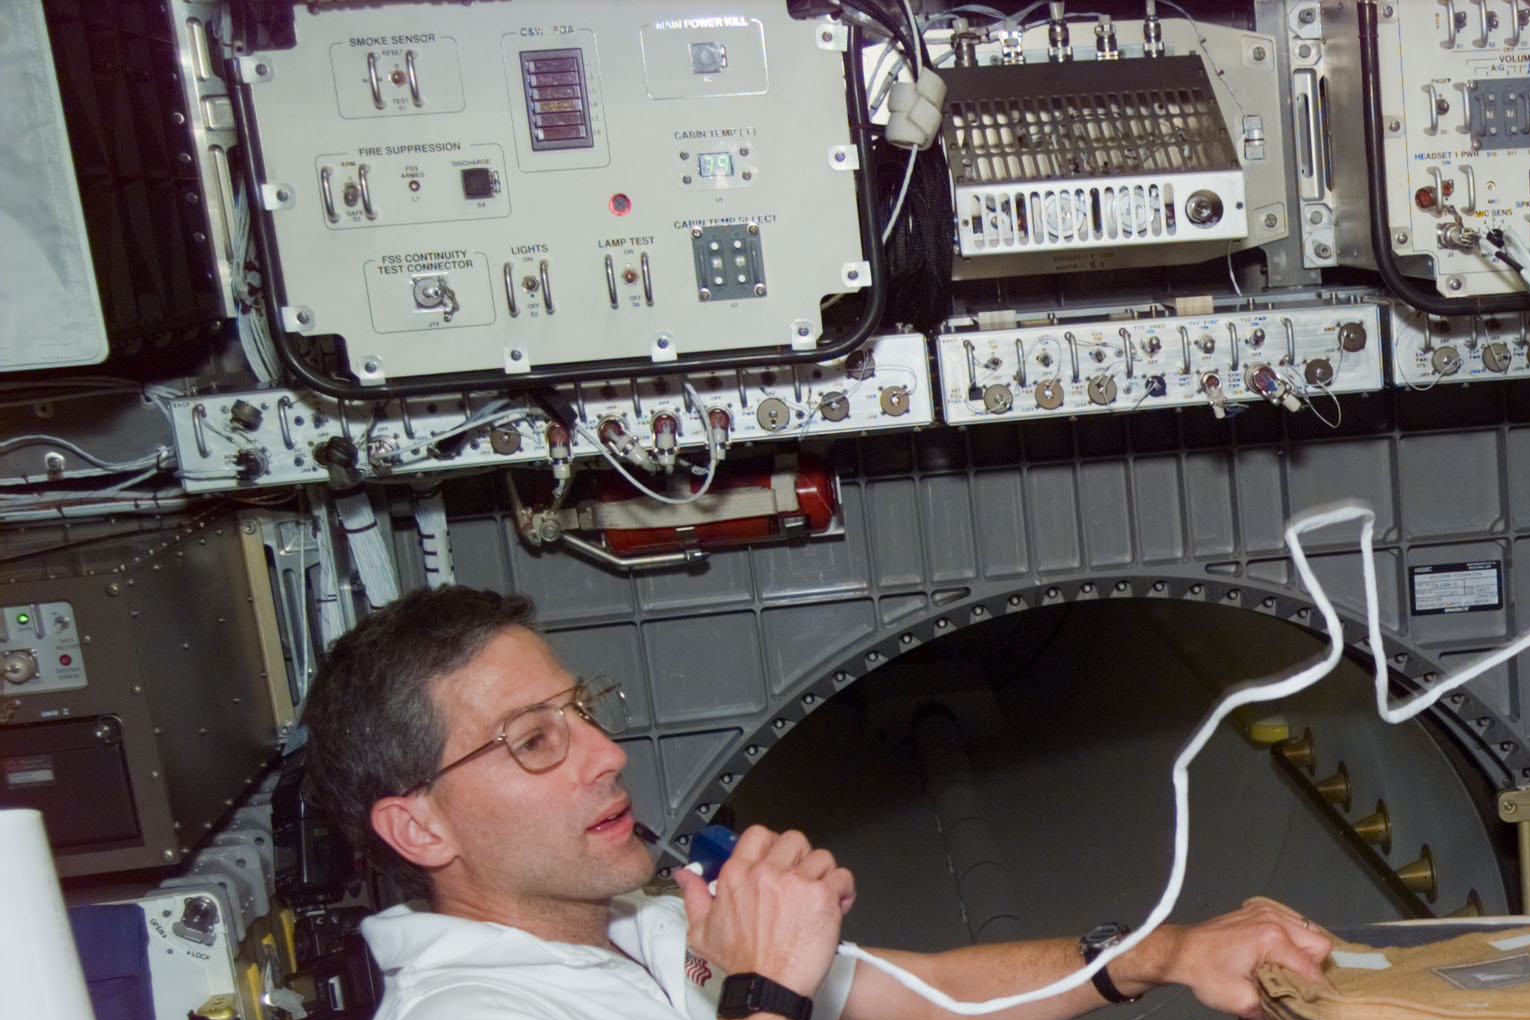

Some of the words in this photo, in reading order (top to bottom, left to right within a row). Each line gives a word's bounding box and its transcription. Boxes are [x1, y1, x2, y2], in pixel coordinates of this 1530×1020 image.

[656, 20, 681, 30] MAIN
[684, 18, 722, 29] POWER
[725, 16, 748, 26] KILL
[349, 35, 388, 47] SMOKE
[391, 33, 436, 45] SENSOR
[674, 130, 706, 140] CABIN
[710, 129, 736, 138] TEMP
[359, 147, 382, 157] FIRE
[385, 142, 461, 155] SUPPRESSION
[1415, 152, 1452, 160] HEADSET
[451, 159, 491, 167] DISCHARGE
[674, 219, 706, 229] CABIN
[598, 239, 626, 248] LAMP
[629, 236, 655, 246] TEST
[511, 244, 549, 255] LIGHTS
[382, 254, 402, 264] FSS
[405, 250, 467, 262] CONTINUITY
[378, 264, 403, 275] TEST
[407, 260, 473, 272] CONNECTOR
[150, 918, 165, 935] OPEN
[192, 951, 209, 960] LOCK
